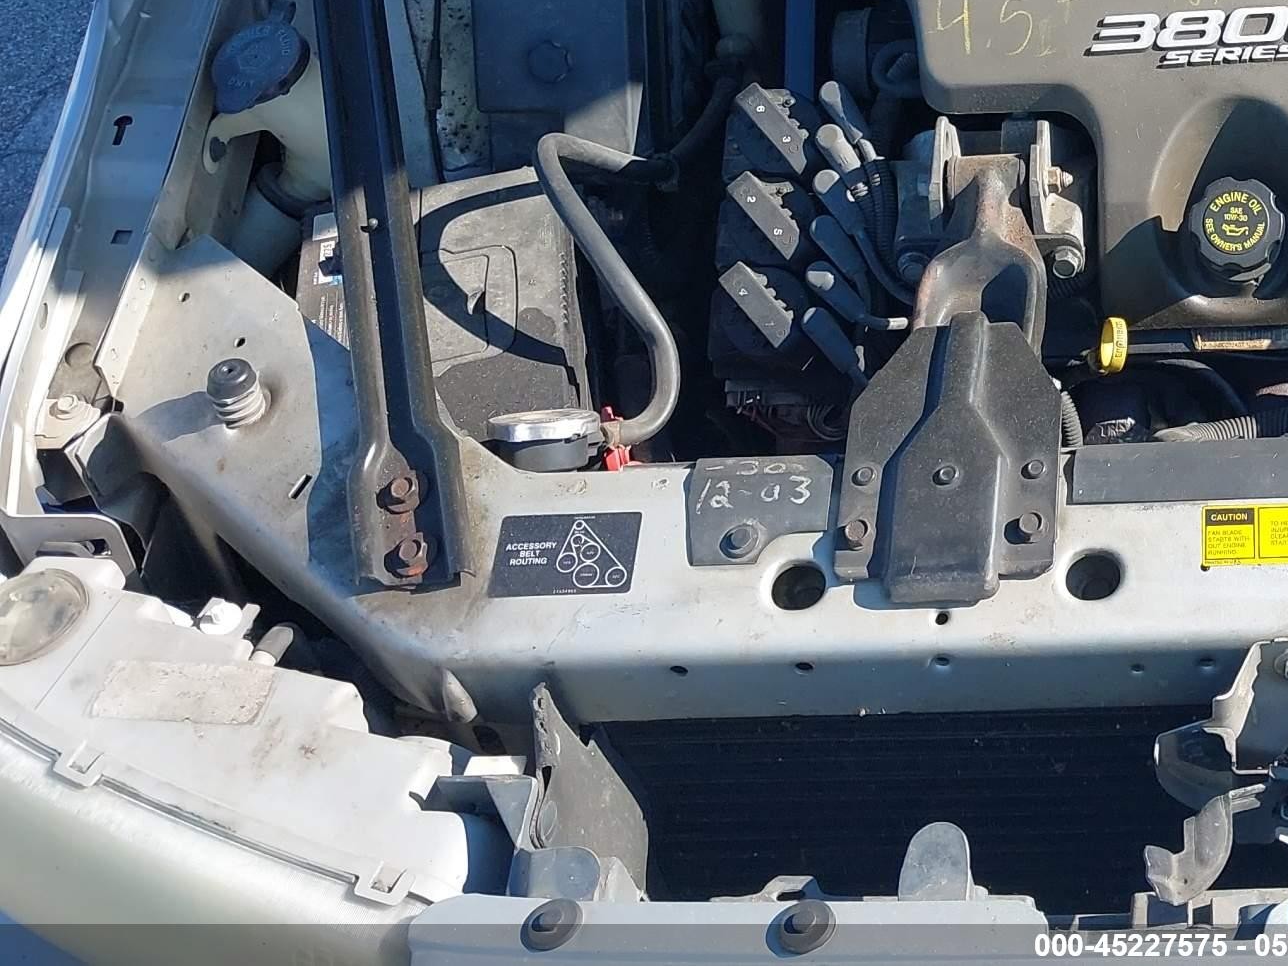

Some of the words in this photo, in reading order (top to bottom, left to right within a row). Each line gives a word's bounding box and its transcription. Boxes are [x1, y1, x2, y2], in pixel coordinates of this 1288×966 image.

[1209, 191, 1249, 212] ENGINE
[1248, 199, 1263, 216] OIL
[1230, 206, 1243, 214] SAE
[746, 195, 757, 203] 2
[773, 228, 783, 236] 5
[1205, 218, 1216, 234] SEE
[1210, 233, 1243, 251] OWNER'S
[1243, 222, 1266, 249] MANUAL
[1210, 513, 1248, 521] CAUTION
[505, 541, 558, 552] ACCESSORY
[519, 550, 541, 558] BELT
[509, 557, 548, 566] ROUTING
